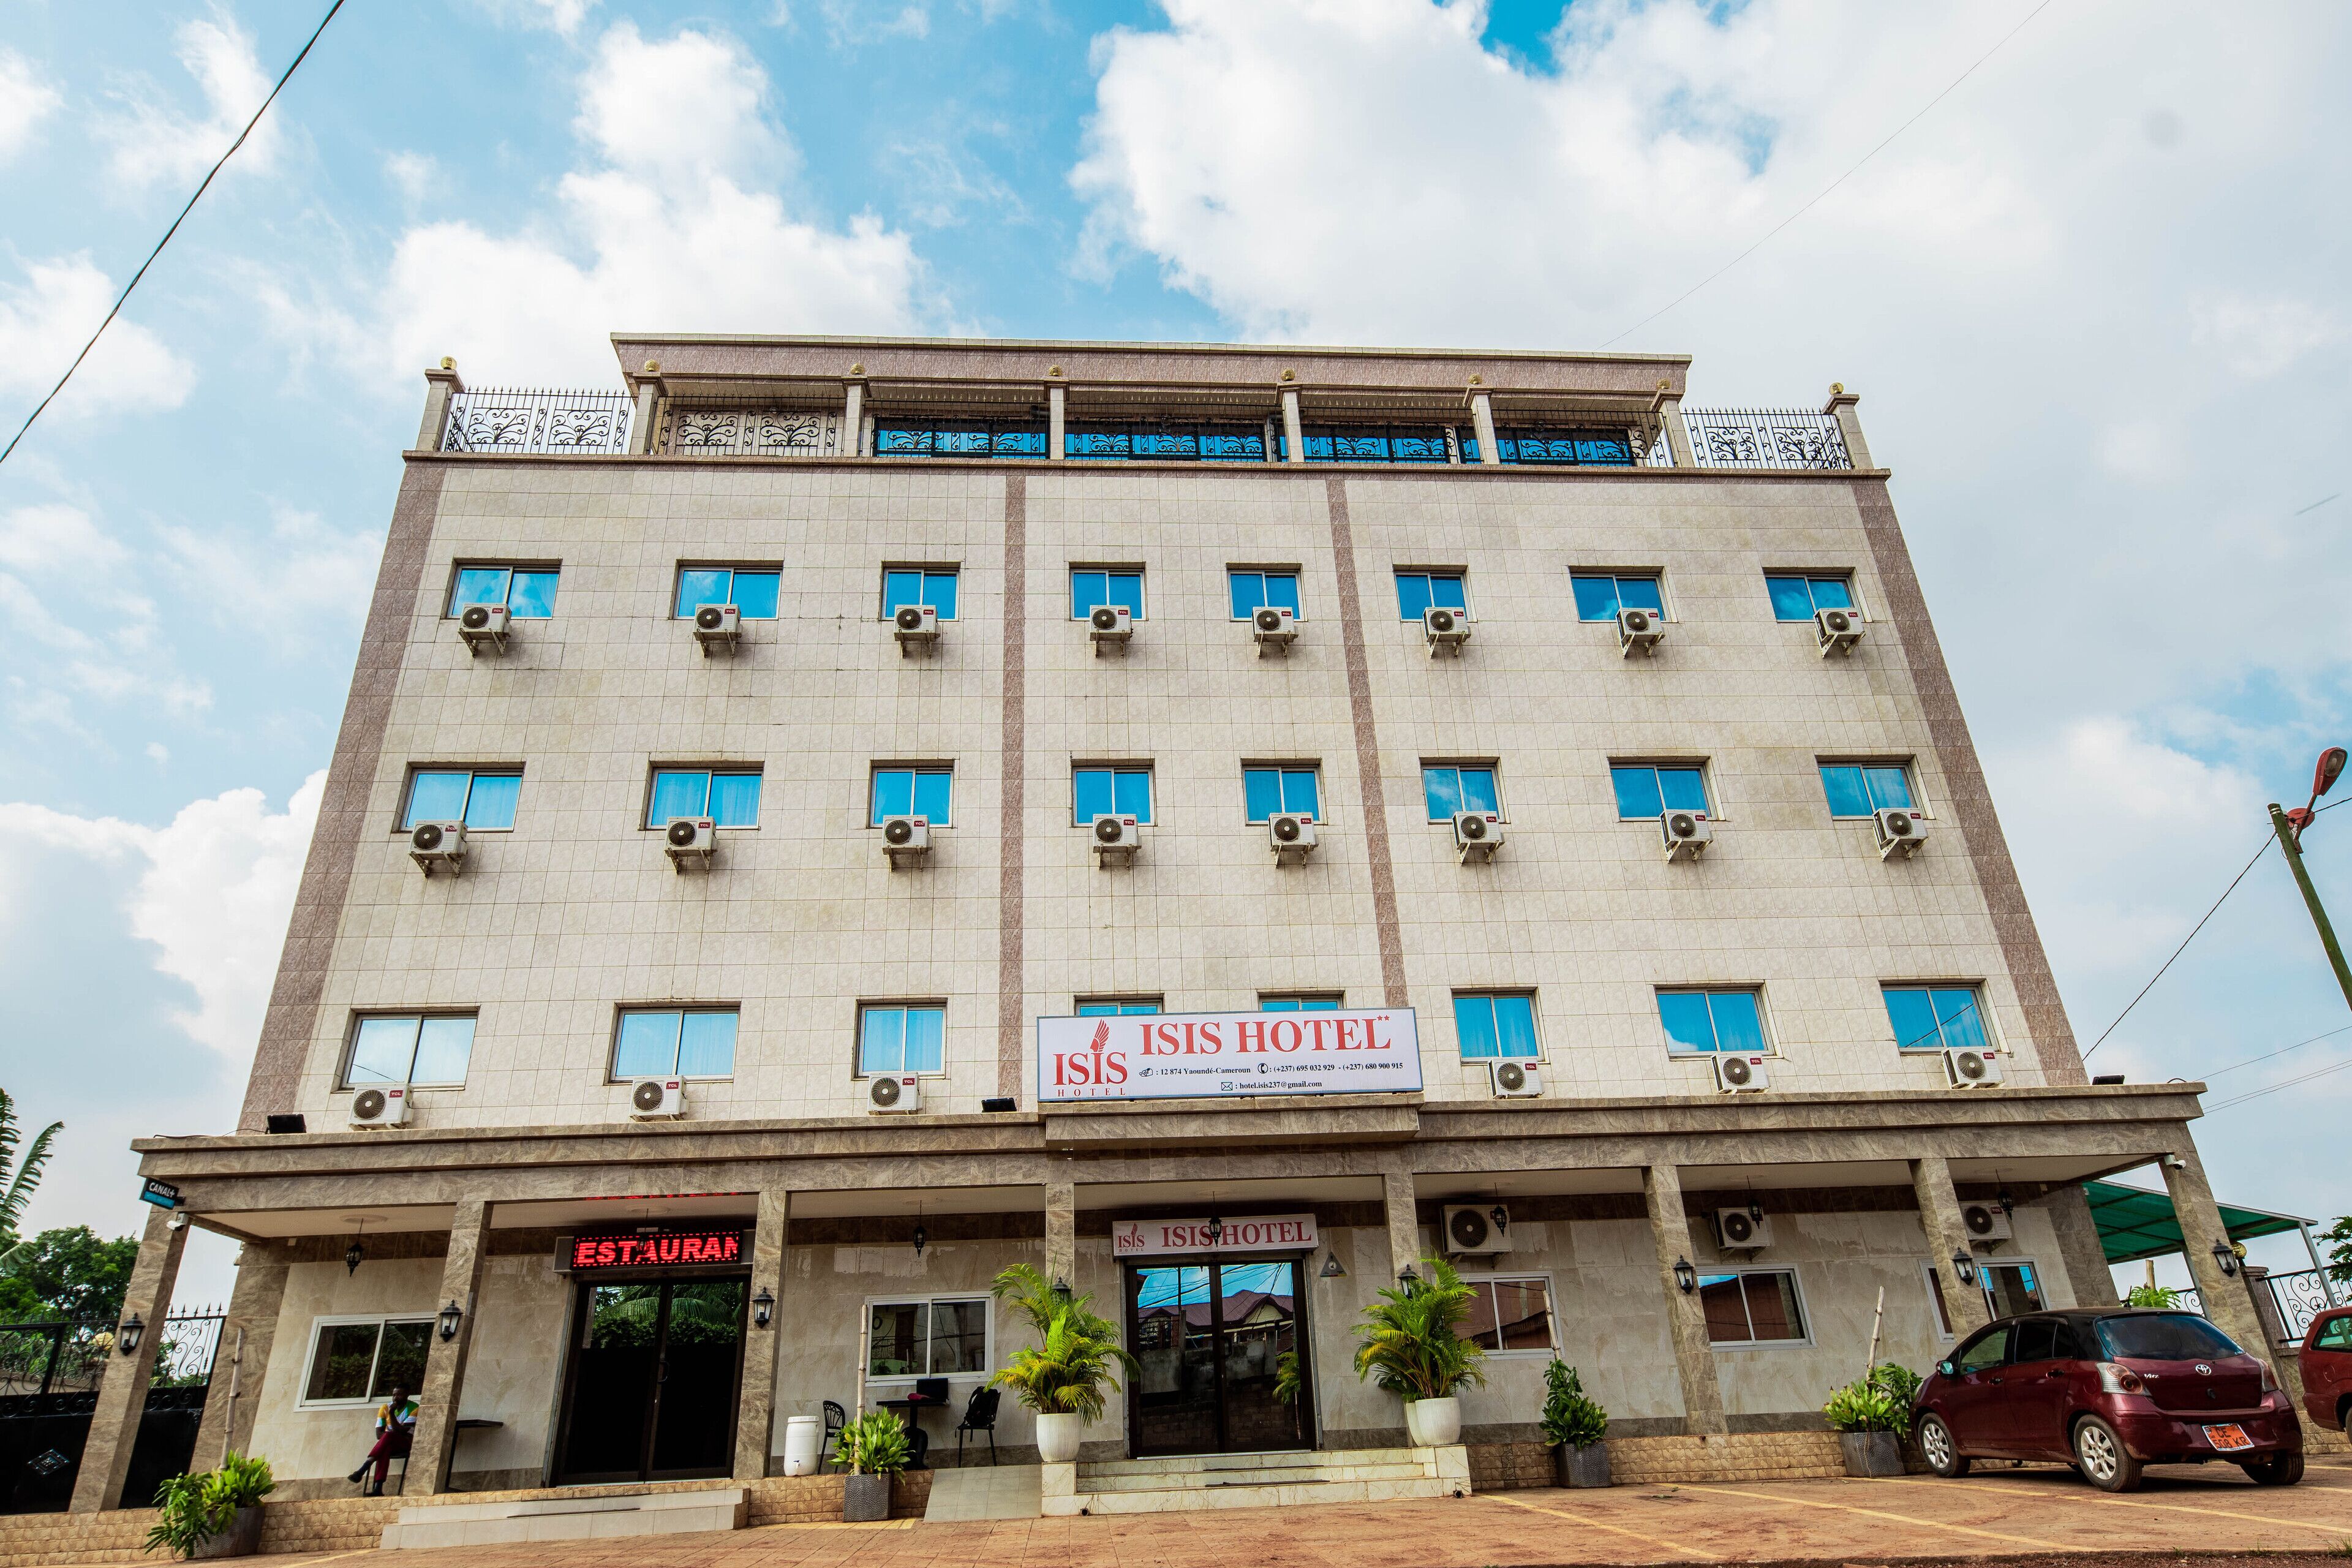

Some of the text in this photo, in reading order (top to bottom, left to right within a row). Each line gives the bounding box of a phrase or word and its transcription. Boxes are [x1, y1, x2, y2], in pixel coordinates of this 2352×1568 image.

[1139, 1019, 1392, 1056] ISIS HOTEL
[1053, 1052, 1128, 1086] ISIS
[1273, 1065, 1295, 1073] (+237)
[1239, 1080, 1322, 1090] hotel.isis237@gmail.com
[1057, 1087, 1126, 1097] HOTEL
[149, 1182, 175, 1197] CANAL+
[1161, 1221, 1312, 1248] ISIS HOTEL
[1118, 1235, 1145, 1248] ISIS
[576, 1237, 737, 1264] ESTAURAN
[2215, 1427, 2231, 1438] CE
[2233, 1436, 2252, 1447] KR
